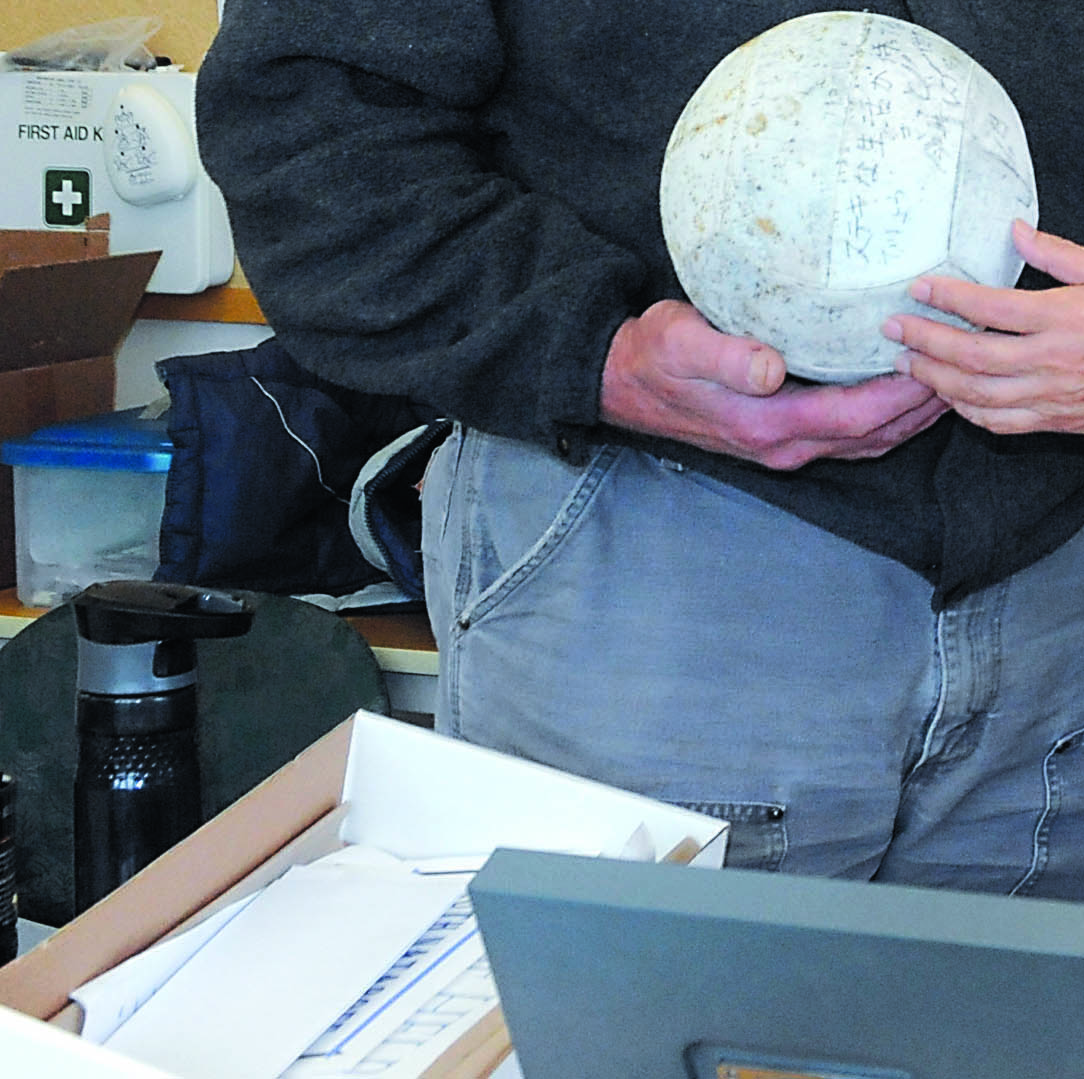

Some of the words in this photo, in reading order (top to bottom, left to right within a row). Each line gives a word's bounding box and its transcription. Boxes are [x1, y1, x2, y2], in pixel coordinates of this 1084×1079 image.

[18, 124, 59, 140] FIRST
[63, 125, 88, 141] AID
[93, 125, 103, 141] K
